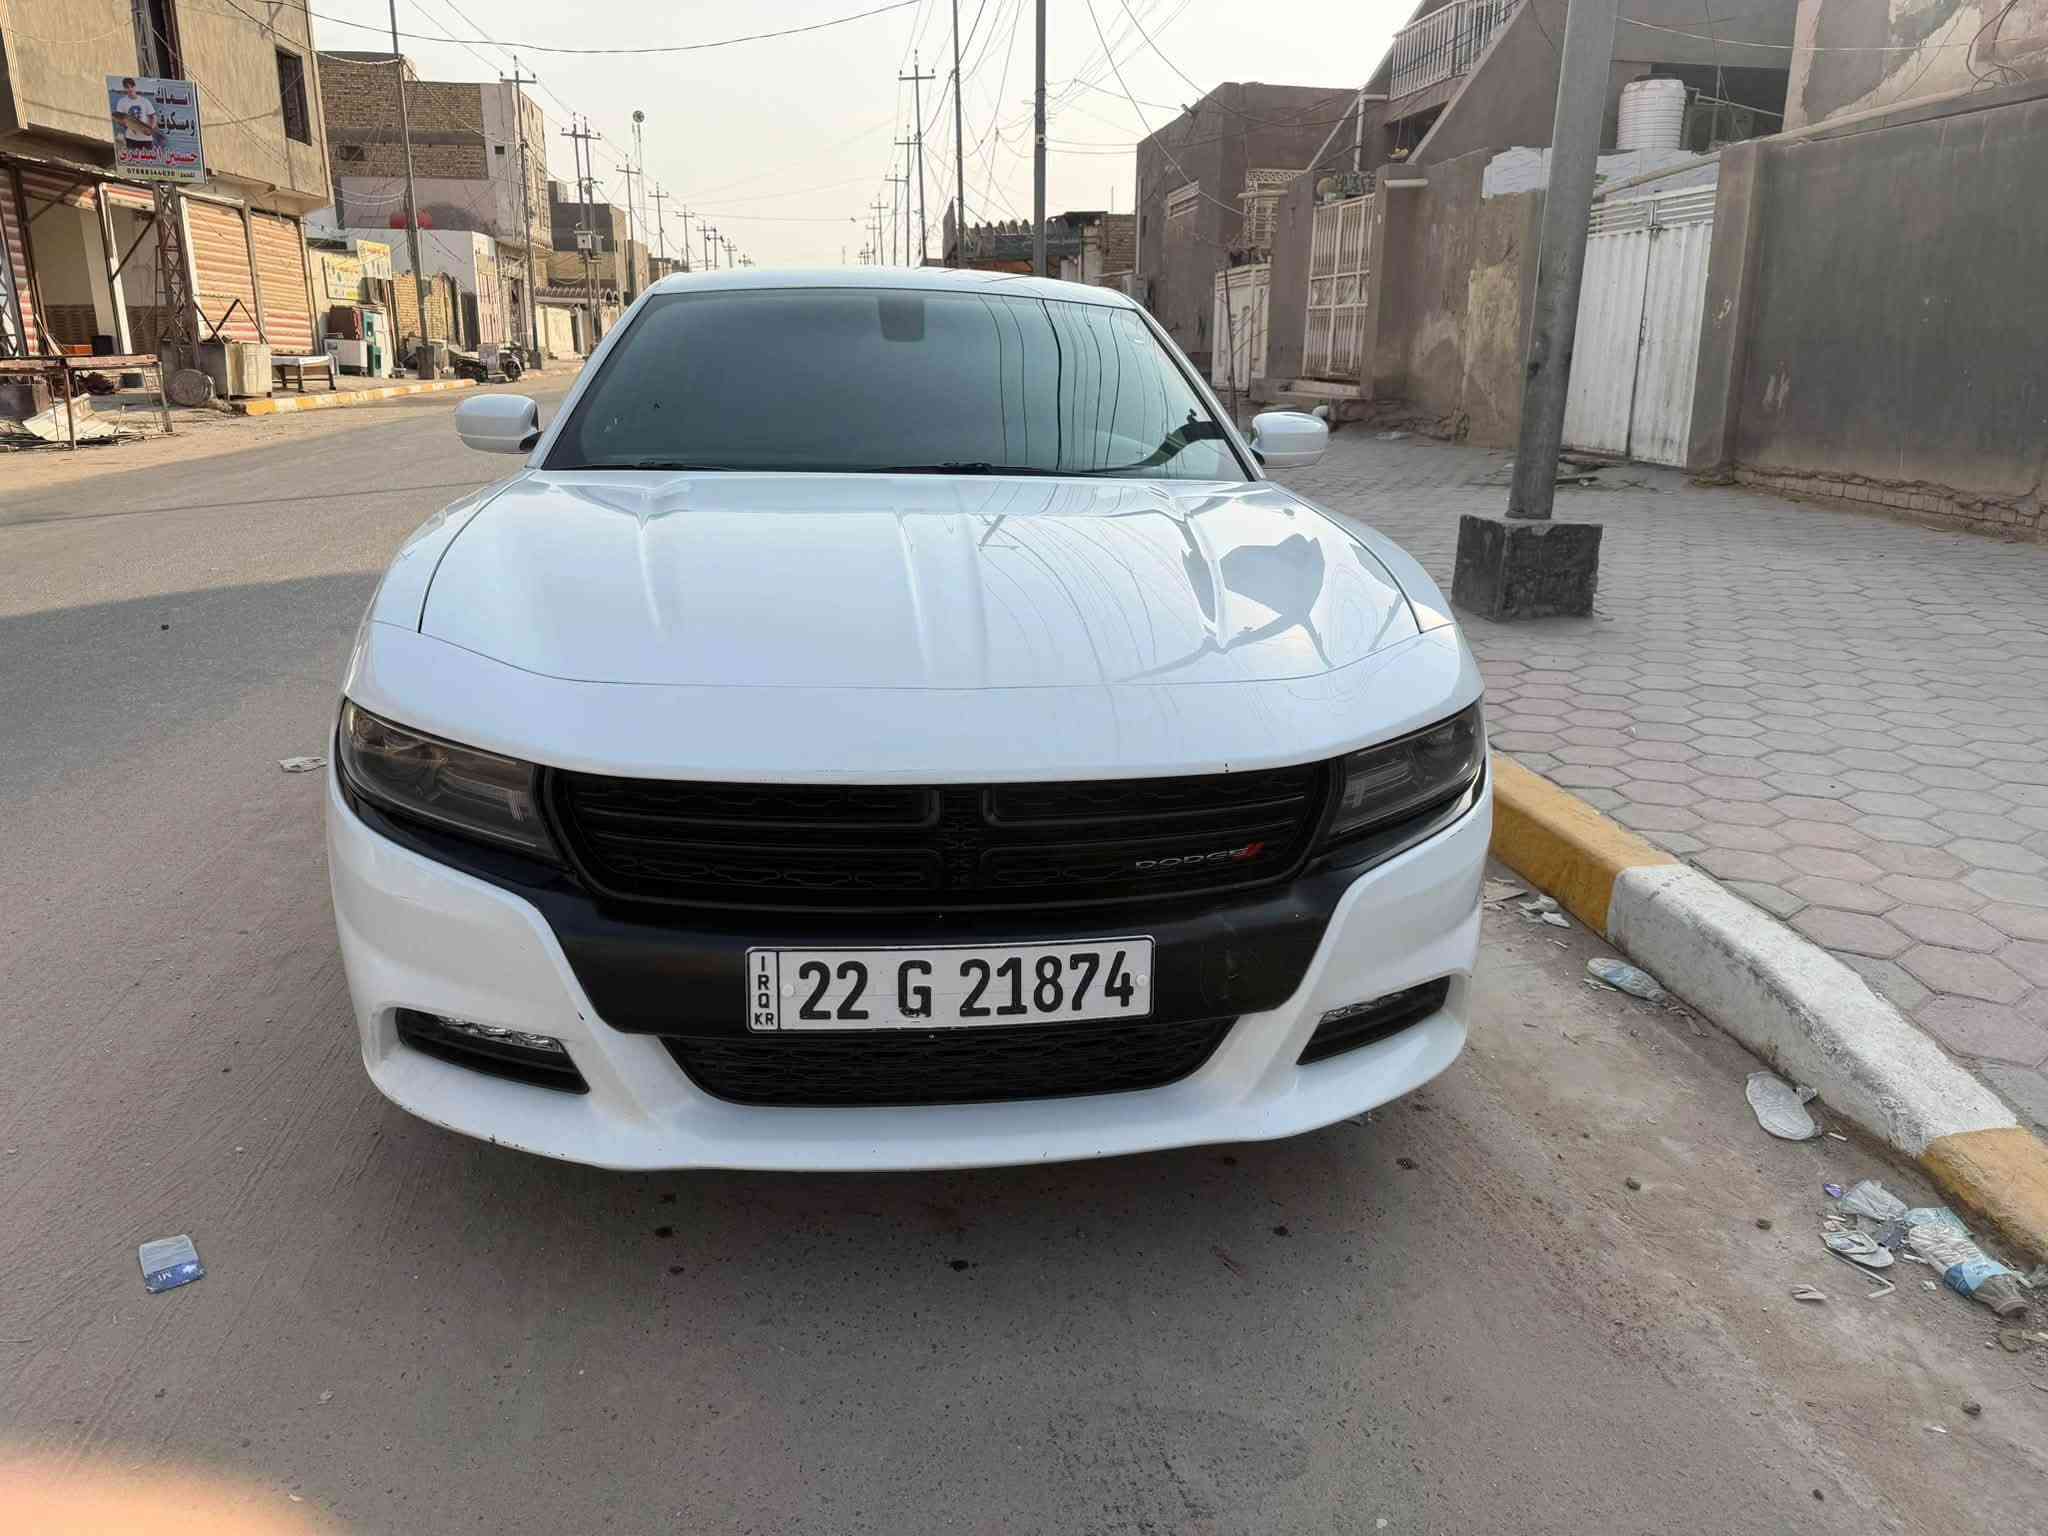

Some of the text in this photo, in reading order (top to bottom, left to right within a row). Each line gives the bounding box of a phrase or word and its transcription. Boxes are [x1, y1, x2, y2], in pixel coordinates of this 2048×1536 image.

[1136, 847, 1249, 868] DODGE
[757, 955, 770, 1009] IRQ
[799, 950, 1134, 1020] 22 G 21874
[754, 1012, 774, 1025] KR
